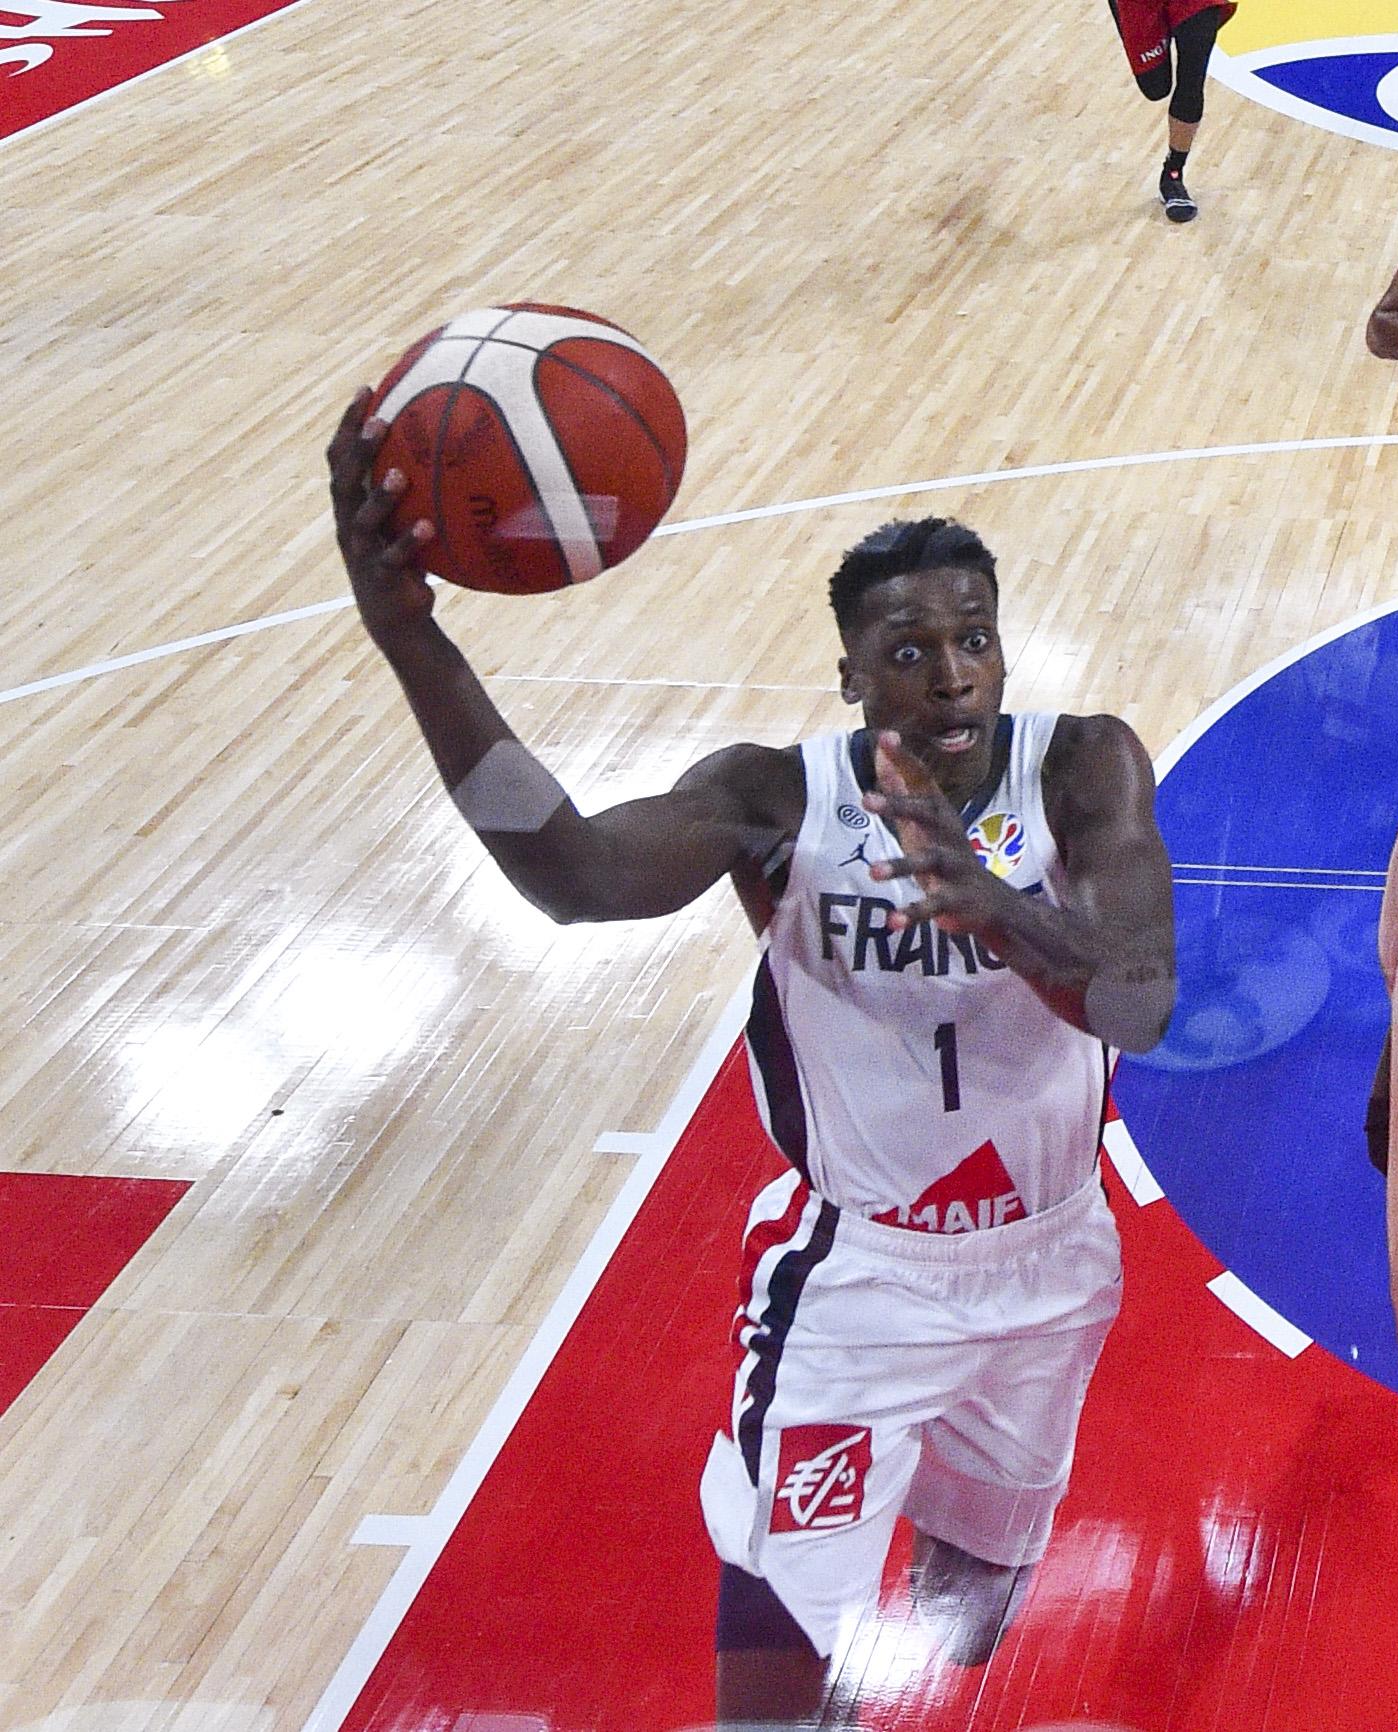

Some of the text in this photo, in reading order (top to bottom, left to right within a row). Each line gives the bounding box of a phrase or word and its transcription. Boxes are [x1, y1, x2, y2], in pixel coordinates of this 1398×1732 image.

[818, 892, 1008, 977] FRAN
[933, 1021, 960, 1113] 1
[896, 1190, 1020, 1234] MAIF
